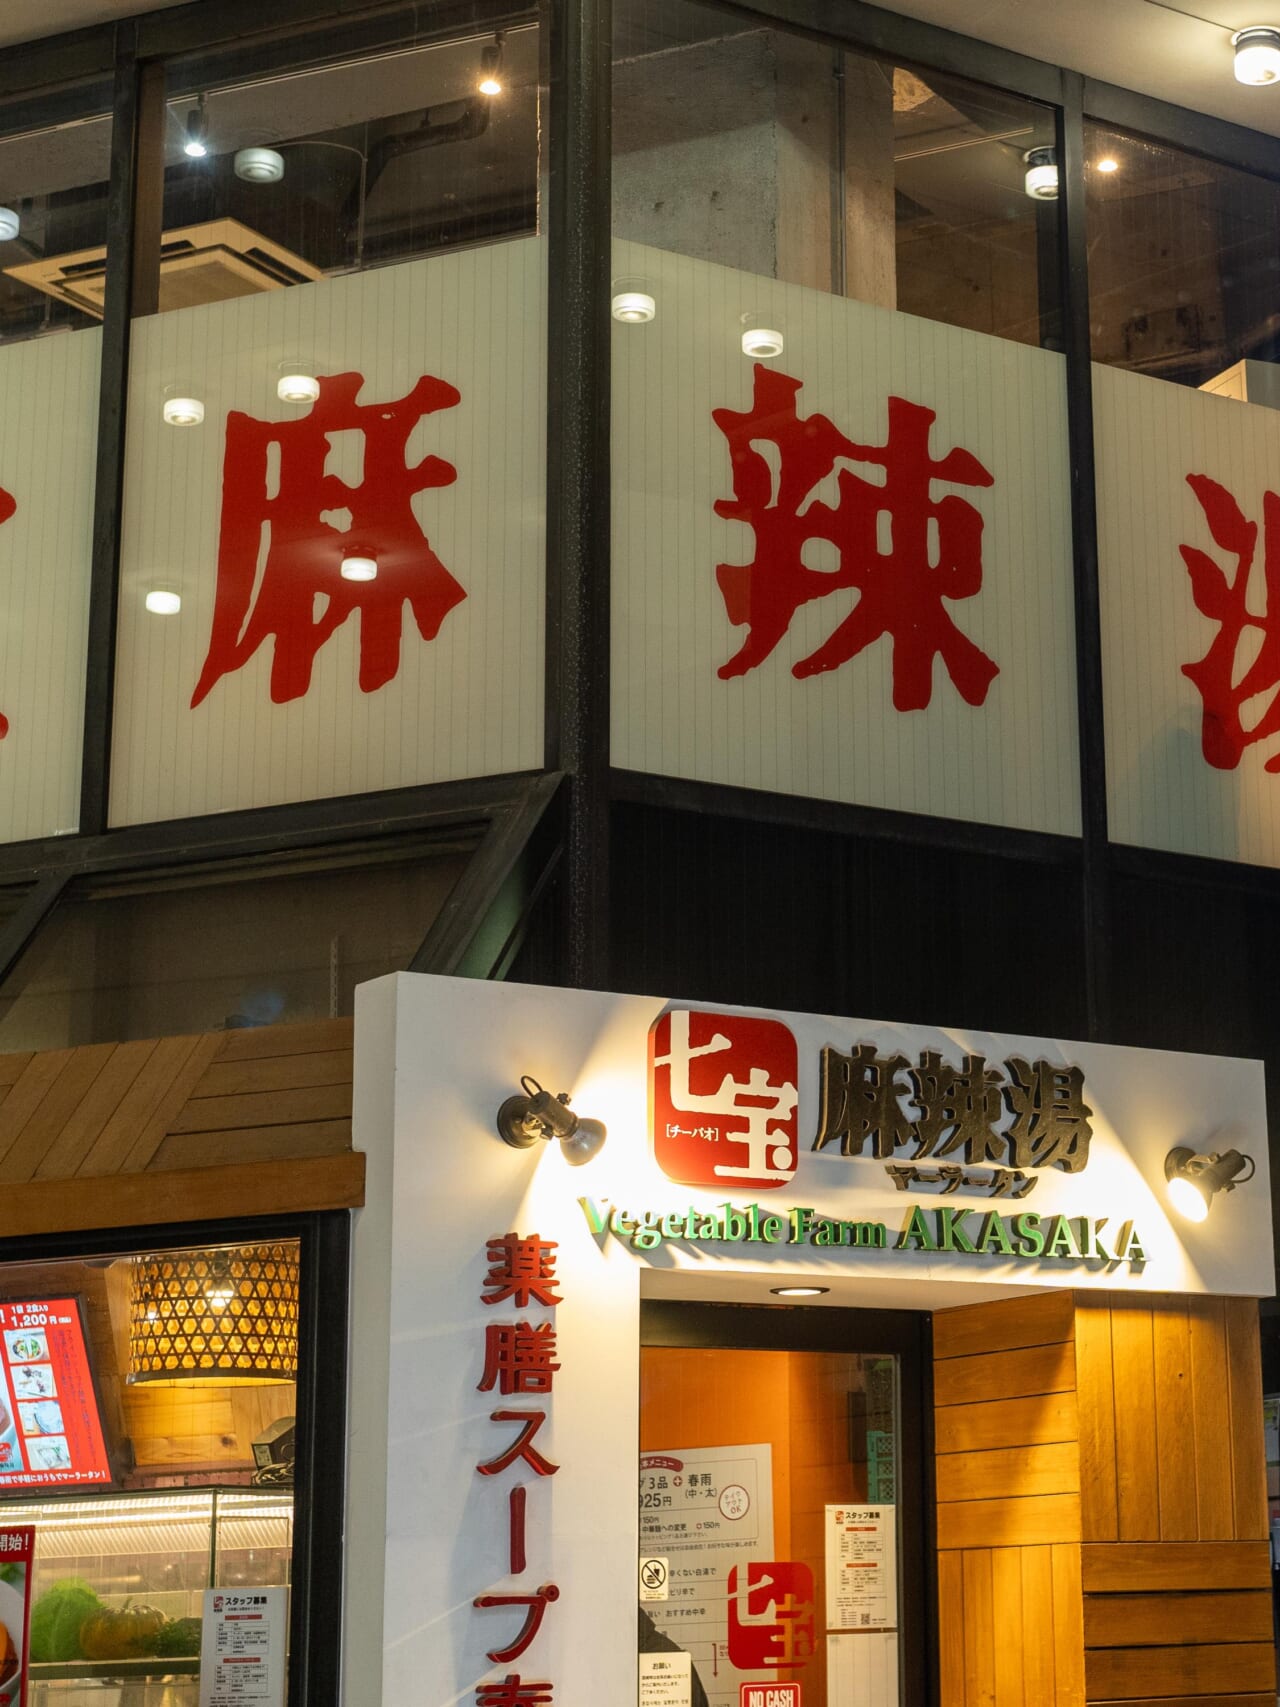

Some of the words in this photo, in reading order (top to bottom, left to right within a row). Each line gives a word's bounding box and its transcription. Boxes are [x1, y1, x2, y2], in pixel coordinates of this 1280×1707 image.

[655, 1010, 798, 1180] 七宝
[811, 1043, 1093, 1173] 麻辣湯
[885, 1164, 1038, 1199] マーラータン
[578, 1197, 783, 1250] Vegetable
[788, 1206, 888, 1249] Farm
[894, 1203, 1152, 1262] AKASAKA
[688, 1473, 712, 1487] 春雨
[748, 1691, 764, 1707] NO
[766, 1690, 794, 1707] CASH
